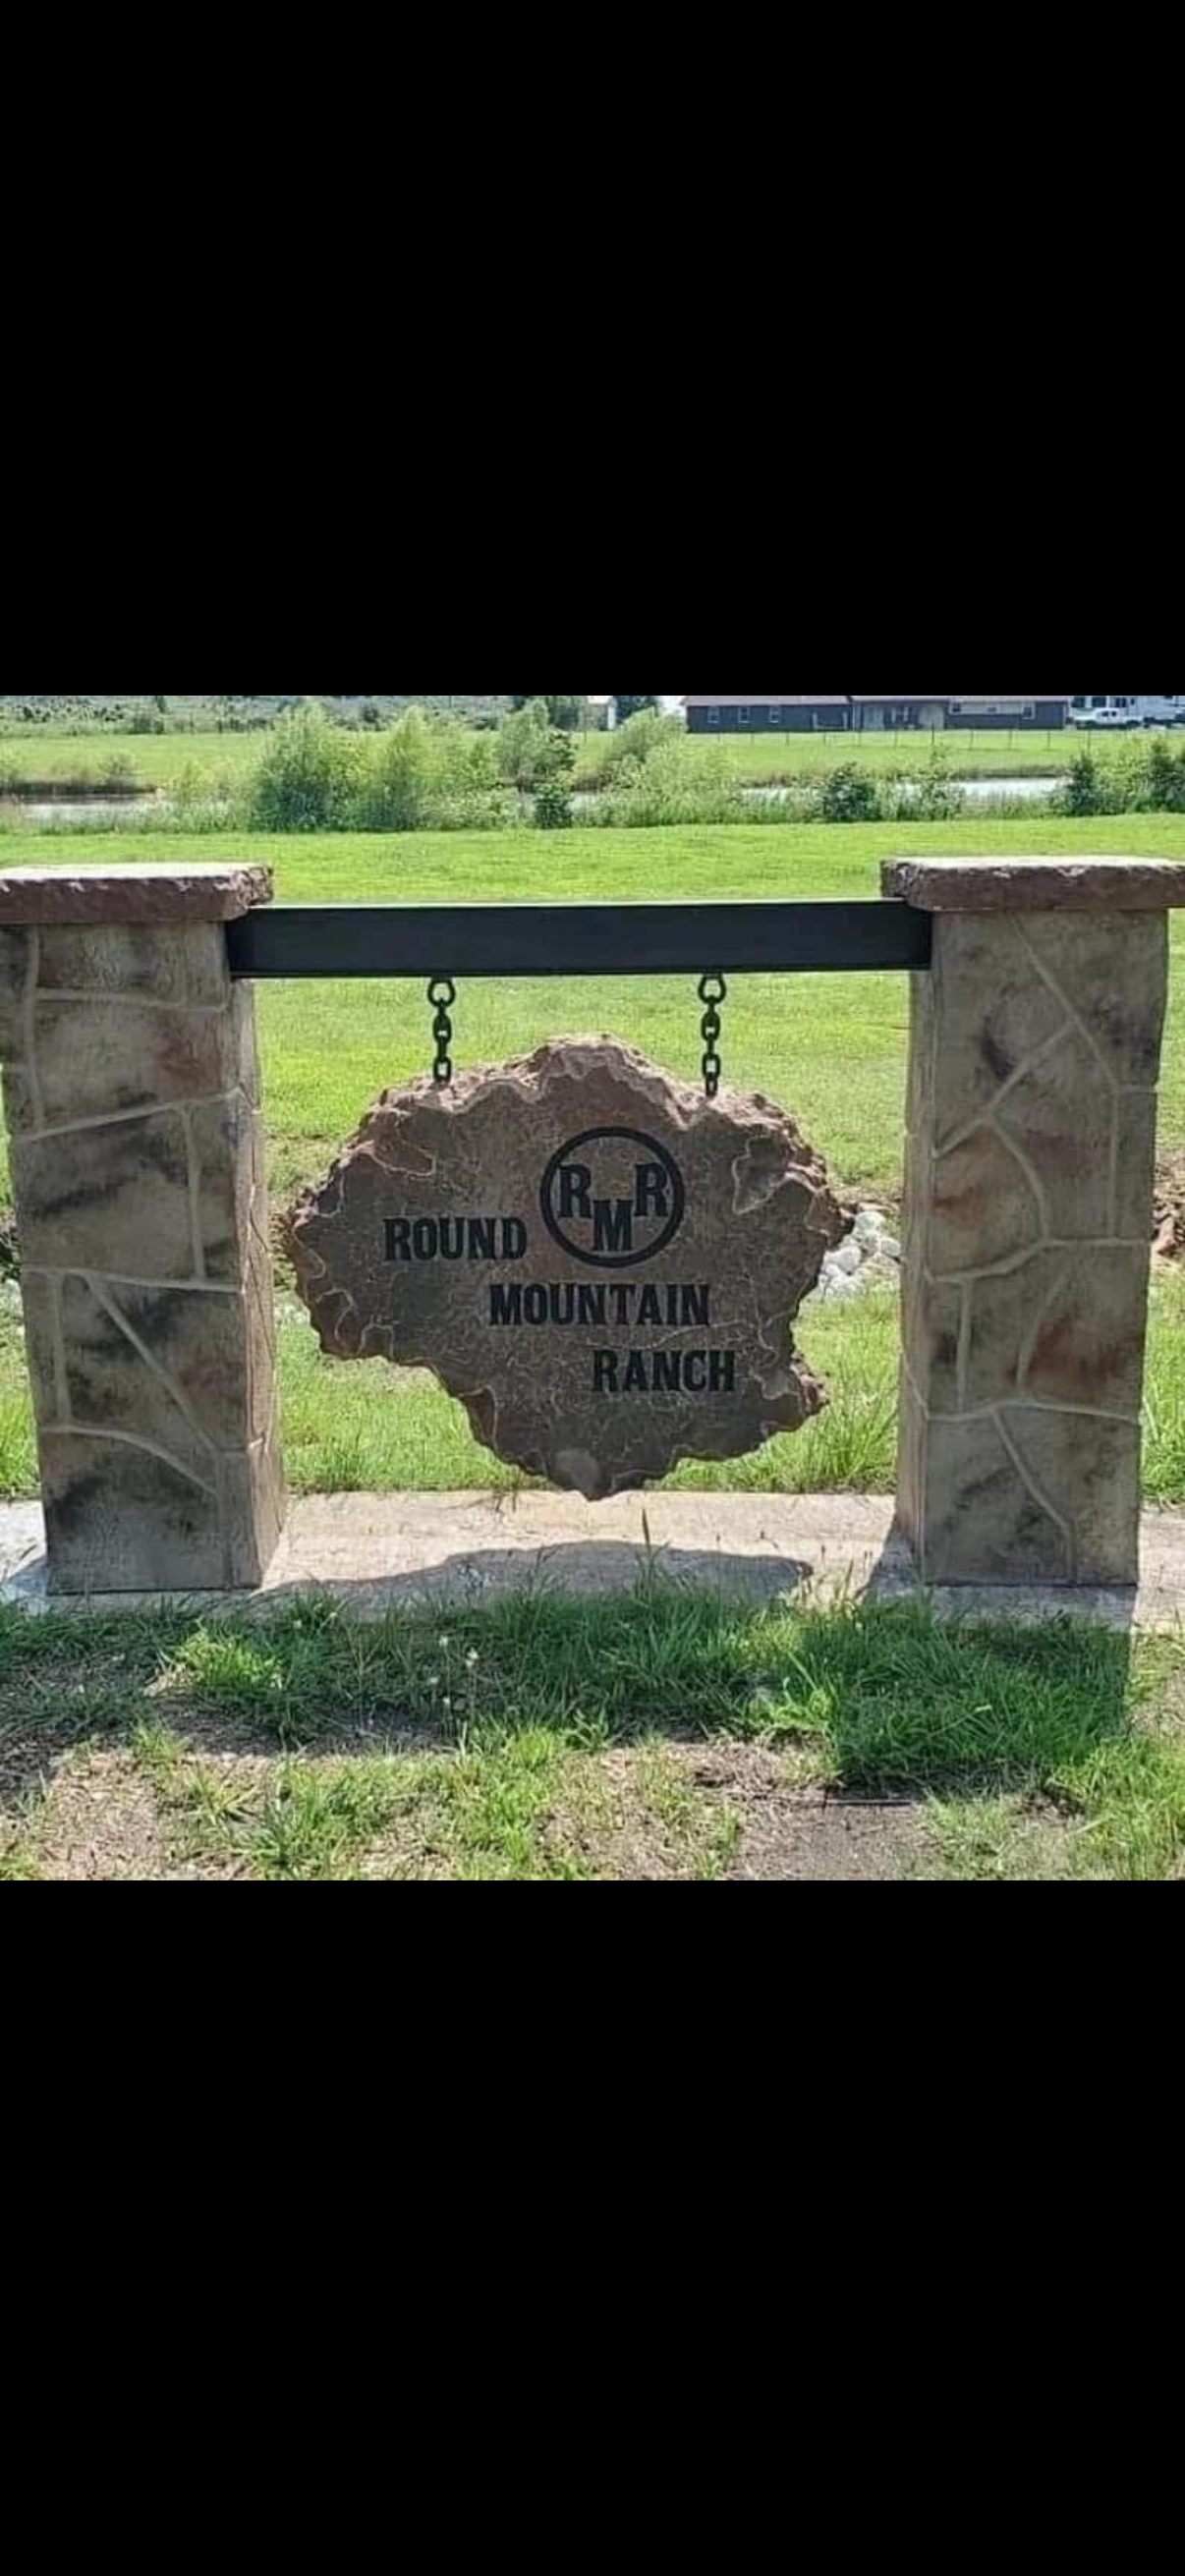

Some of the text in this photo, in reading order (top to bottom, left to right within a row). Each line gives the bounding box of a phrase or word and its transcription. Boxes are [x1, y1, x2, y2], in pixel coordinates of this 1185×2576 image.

[557, 1162, 669, 1252] RMR
[382, 1216, 528, 1261] ROUND
[488, 1282, 710, 1327] MOUNTAIN
[592, 1349, 736, 1393] RANCH
